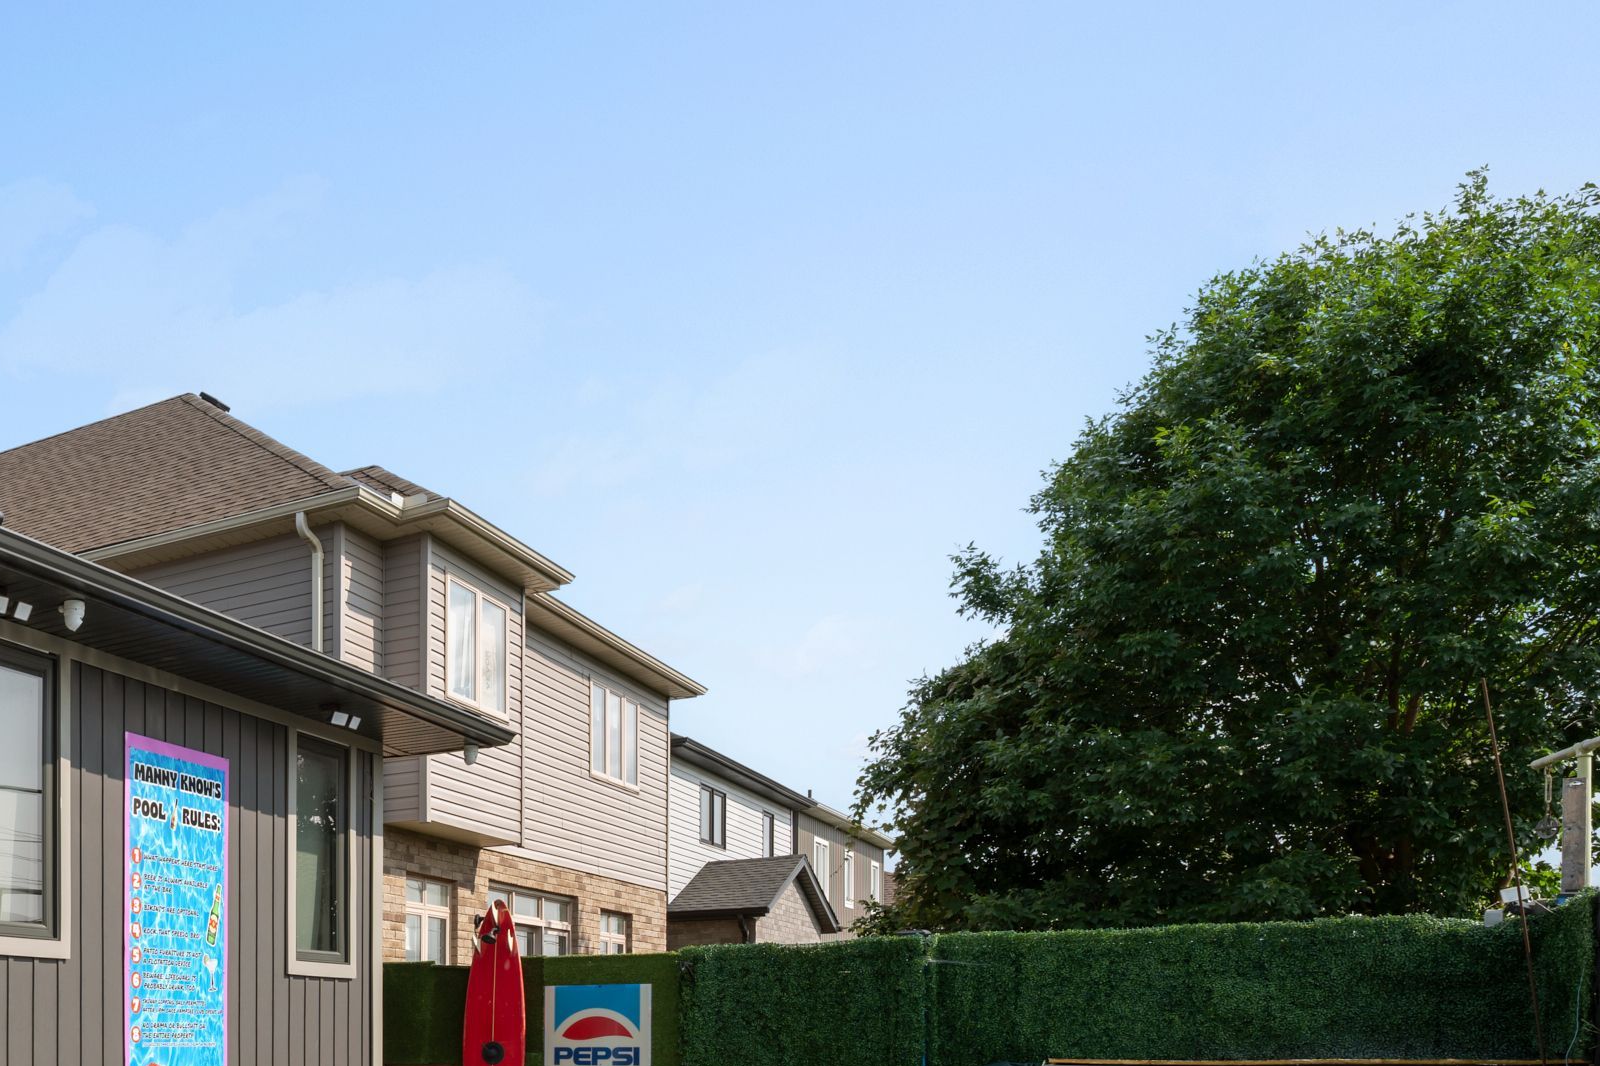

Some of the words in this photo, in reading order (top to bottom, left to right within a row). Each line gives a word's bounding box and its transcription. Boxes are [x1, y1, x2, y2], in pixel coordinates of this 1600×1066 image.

[134, 763, 177, 789] MANNY
[180, 774, 222, 799] KNOW'S
[133, 798, 166, 821] POOL
[182, 808, 221, 832] RULES:
[133, 848, 140, 863] 1
[181, 860, 192, 868] HERE
[133, 873, 141, 889] 2
[144, 873, 156, 881] BEER
[133, 898, 140, 913] 3
[133, 922, 140, 938] 4
[133, 947, 140, 963] 5
[133, 972, 140, 988] 6
[133, 997, 140, 1012] 7
[132, 1027, 140, 1041] 8
[554, 1047, 640, 1066] PEPSI
